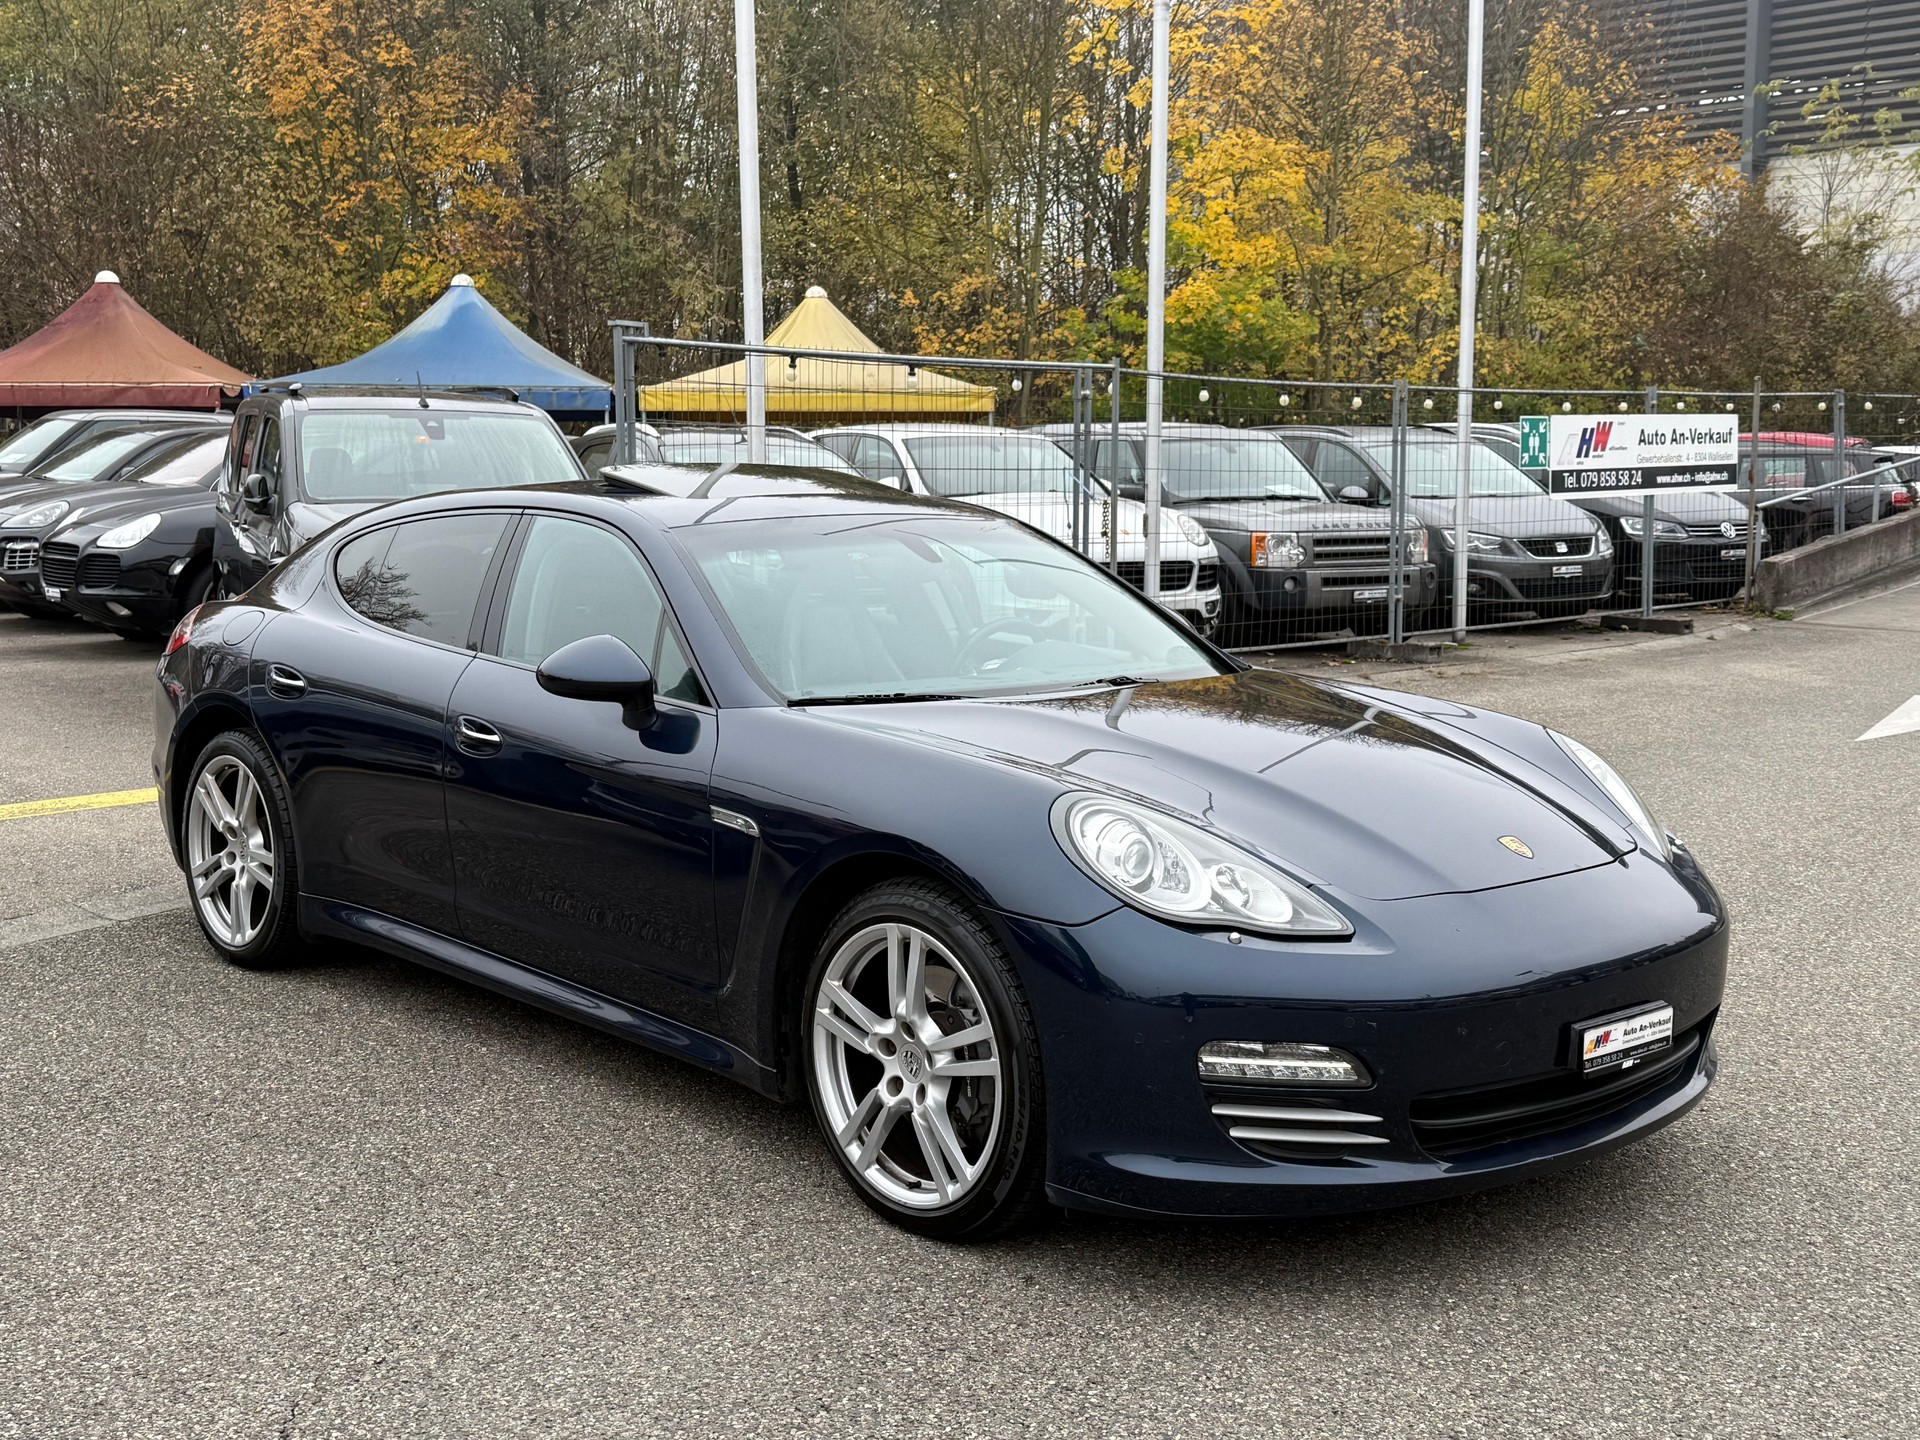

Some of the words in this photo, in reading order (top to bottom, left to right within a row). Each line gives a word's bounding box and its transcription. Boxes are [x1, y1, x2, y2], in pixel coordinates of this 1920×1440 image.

[1638, 428, 1667, 446] Auto
[1670, 427, 1733, 445] An-Verkauf
[1686, 453, 1690, 462] 4
[1563, 472, 1579, 489] Tel.
[1580, 472, 1598, 487] 079
[1600, 471, 1617, 487] 858
[1618, 470, 1630, 486] 58
[1631, 470, 1643, 485] 24
[1656, 472, 1691, 484] www.ahw.ch
[1694, 471, 1729, 484] info@ahw.ch
[1623, 1027, 1638, 1037] Auto
[1639, 1015, 1672, 1032] An-Verkauf
[1585, 1029, 1612, 1055] AHW
